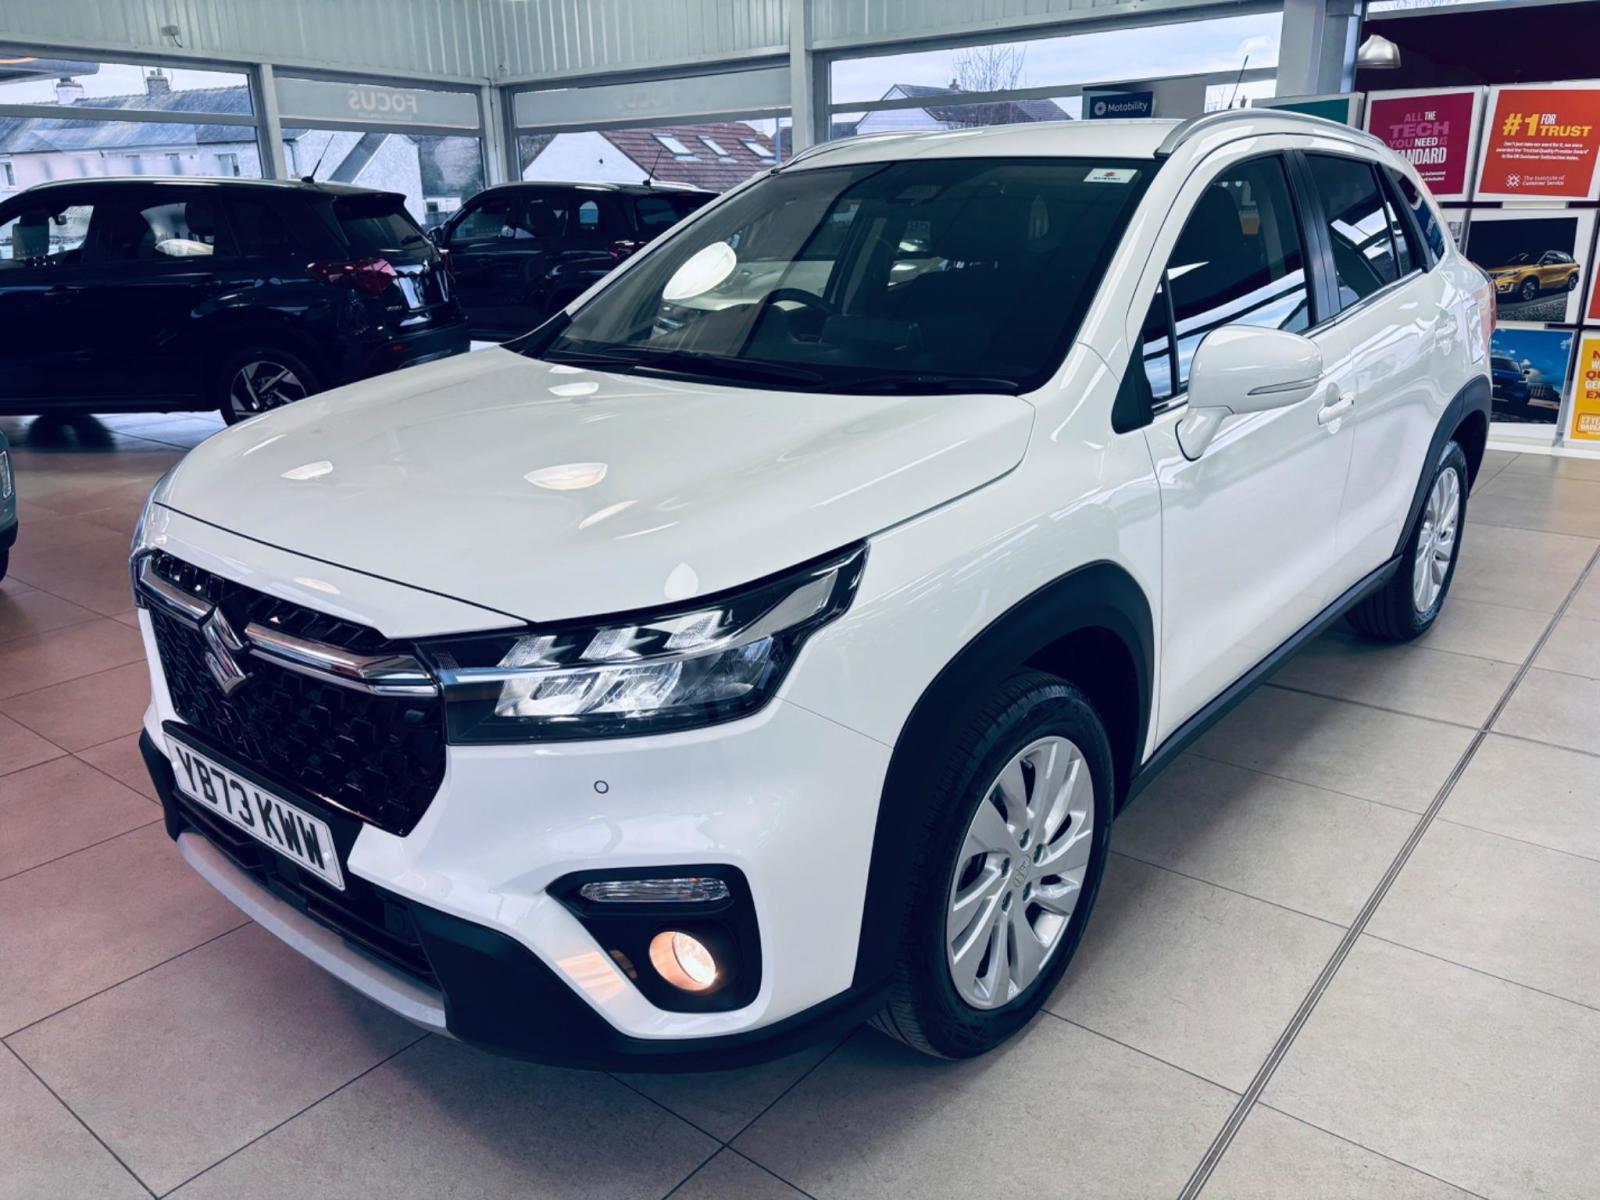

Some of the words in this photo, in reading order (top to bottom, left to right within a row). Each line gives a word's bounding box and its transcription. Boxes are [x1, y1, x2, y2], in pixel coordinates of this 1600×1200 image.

[1403, 112, 1423, 123] ALL
[1424, 111, 1437, 121] THE
[1540, 113, 1558, 125] FOR
[1389, 121, 1449, 138] TECH
[1540, 125, 1593, 137] TRUST
[1388, 138, 1414, 148] YOU
[1414, 136, 1438, 148] NEED
[1439, 136, 1448, 146] IS
[1395, 147, 1447, 166] ANDARD
